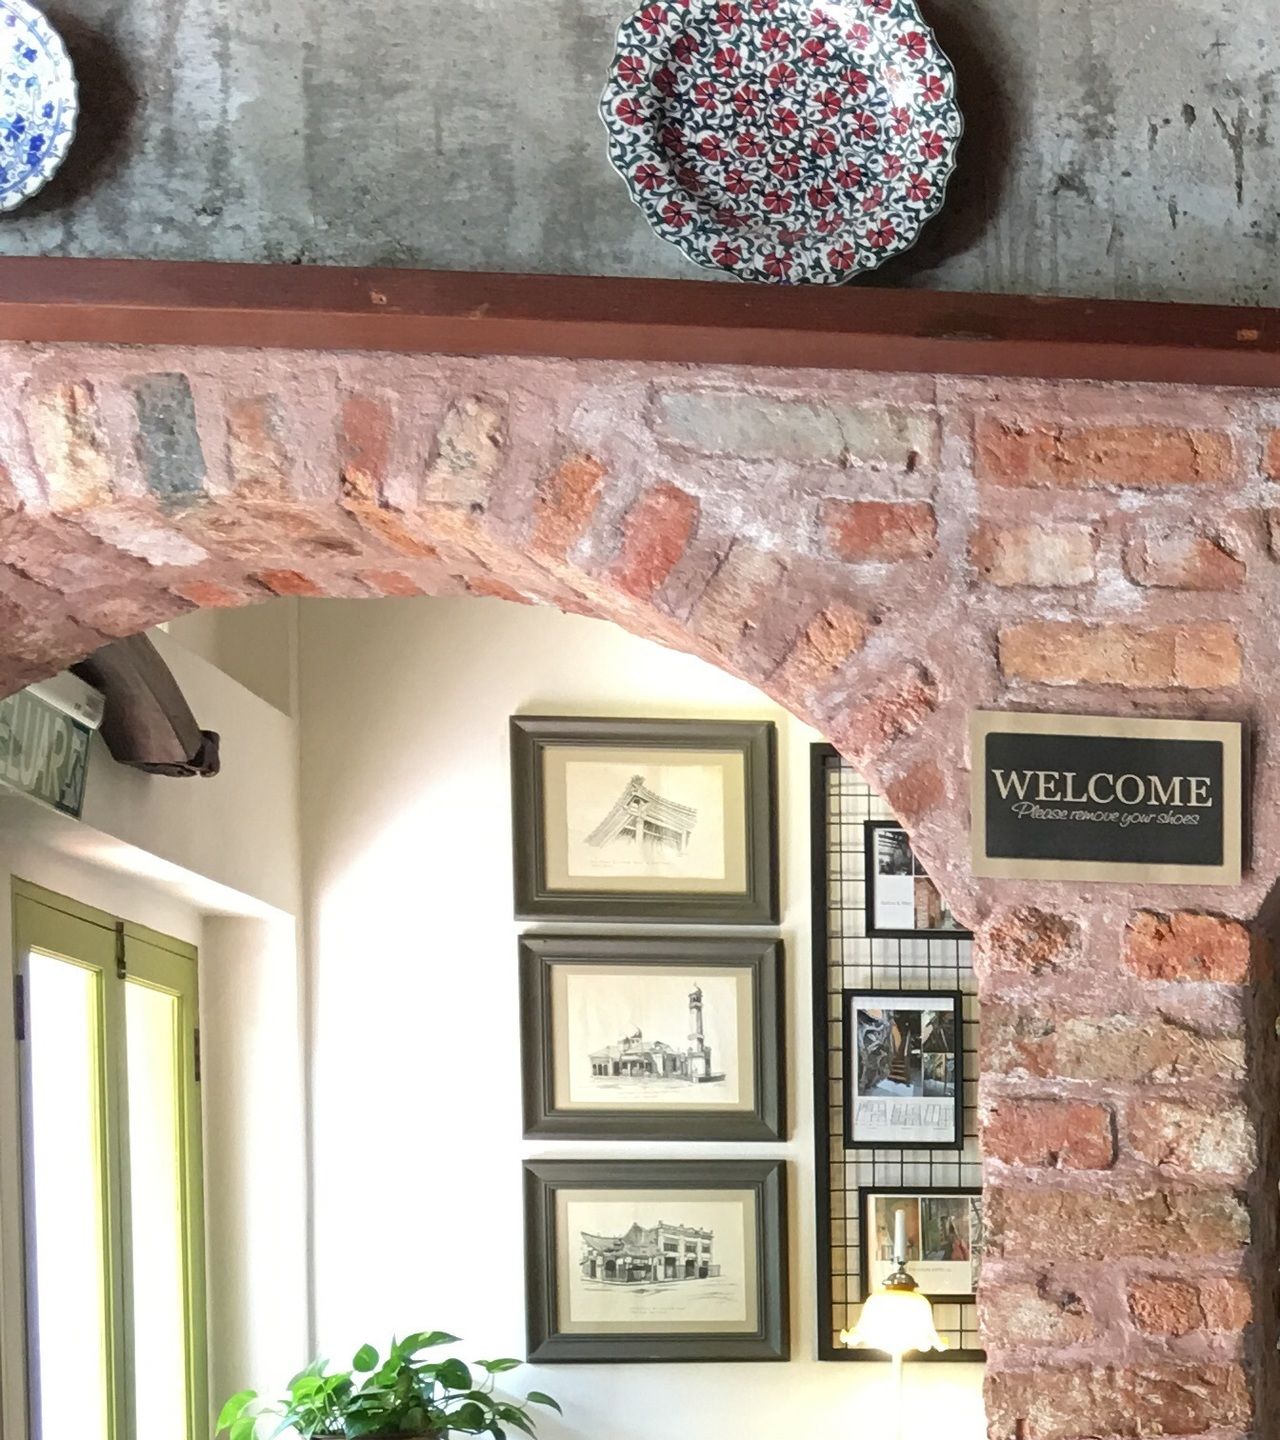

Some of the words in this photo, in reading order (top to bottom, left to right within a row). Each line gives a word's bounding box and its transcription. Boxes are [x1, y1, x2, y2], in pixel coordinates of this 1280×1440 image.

[992, 769, 1212, 807] WELCOME
[1011, 802, 1068, 819] Please
[1069, 811, 1119, 822] remove
[1120, 813, 1156, 827] your
[1156, 810, 1200, 824] shoes
